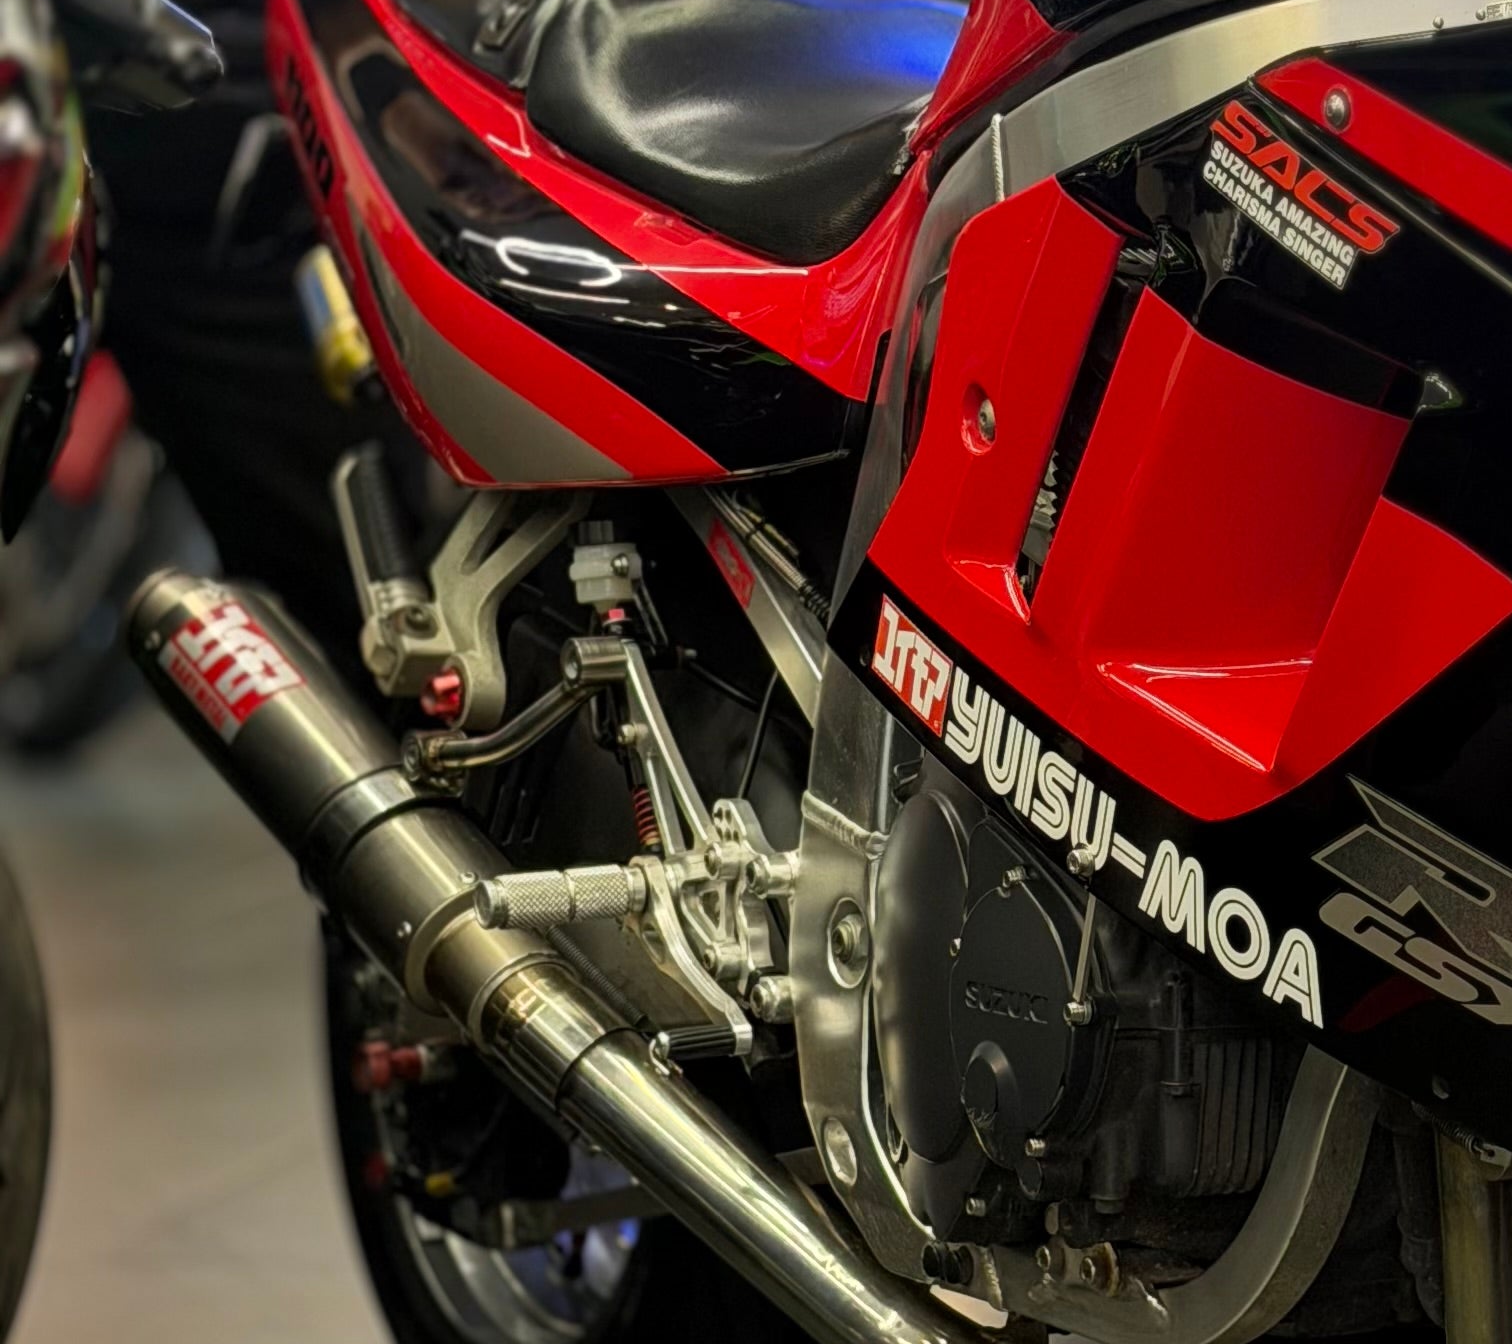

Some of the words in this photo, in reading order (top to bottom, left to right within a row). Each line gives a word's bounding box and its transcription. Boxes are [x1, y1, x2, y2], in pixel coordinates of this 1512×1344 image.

[1203, 160, 1281, 238] CHARISMA
[1282, 227, 1347, 287] SINGER
[1209, 100, 1401, 253] SACS
[1210, 140, 1275, 206] SUZUKA
[1275, 196, 1355, 267] AMAZING
[945, 667, 1324, 1029] YUISU-MOA
